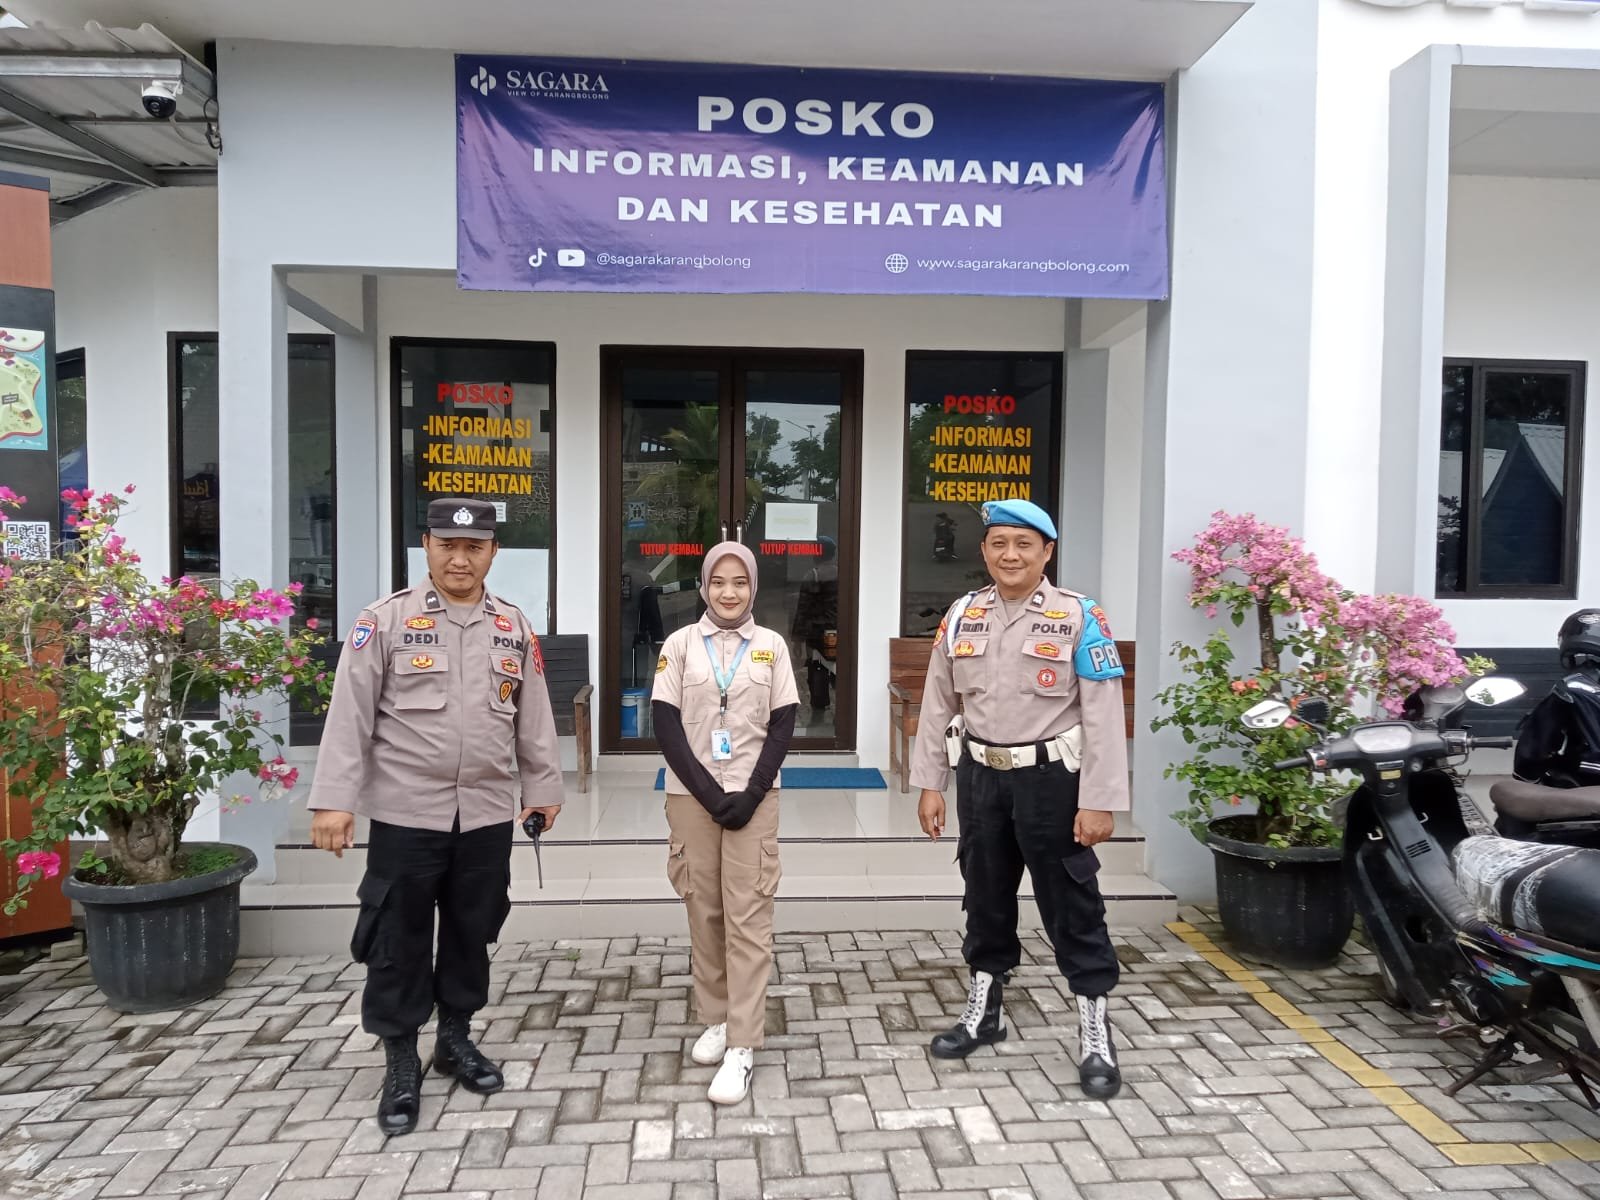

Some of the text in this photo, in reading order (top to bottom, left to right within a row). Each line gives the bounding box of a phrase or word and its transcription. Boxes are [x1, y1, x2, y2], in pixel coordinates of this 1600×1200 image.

[506, 70, 609, 91] SAGARA
[697, 95, 934, 138] POSKO
[533, 147, 1084, 187] INFORMASI, KEAMANAN
[617, 196, 1002, 228] DAN KESEHATAN
[596, 252, 752, 270] @sagarakarangbolong
[916, 256, 1131, 274] www.sagarakarangbolong.com
[437, 383, 514, 404] POSKO
[943, 394, 1016, 415] POSKO
[640, 543, 704, 556] TUTUP KEMBALI
[760, 543, 823, 556] TUTUP KEMBALI
[403, 633, 439, 645] DEDI
[1031, 623, 1073, 636] POLRI
